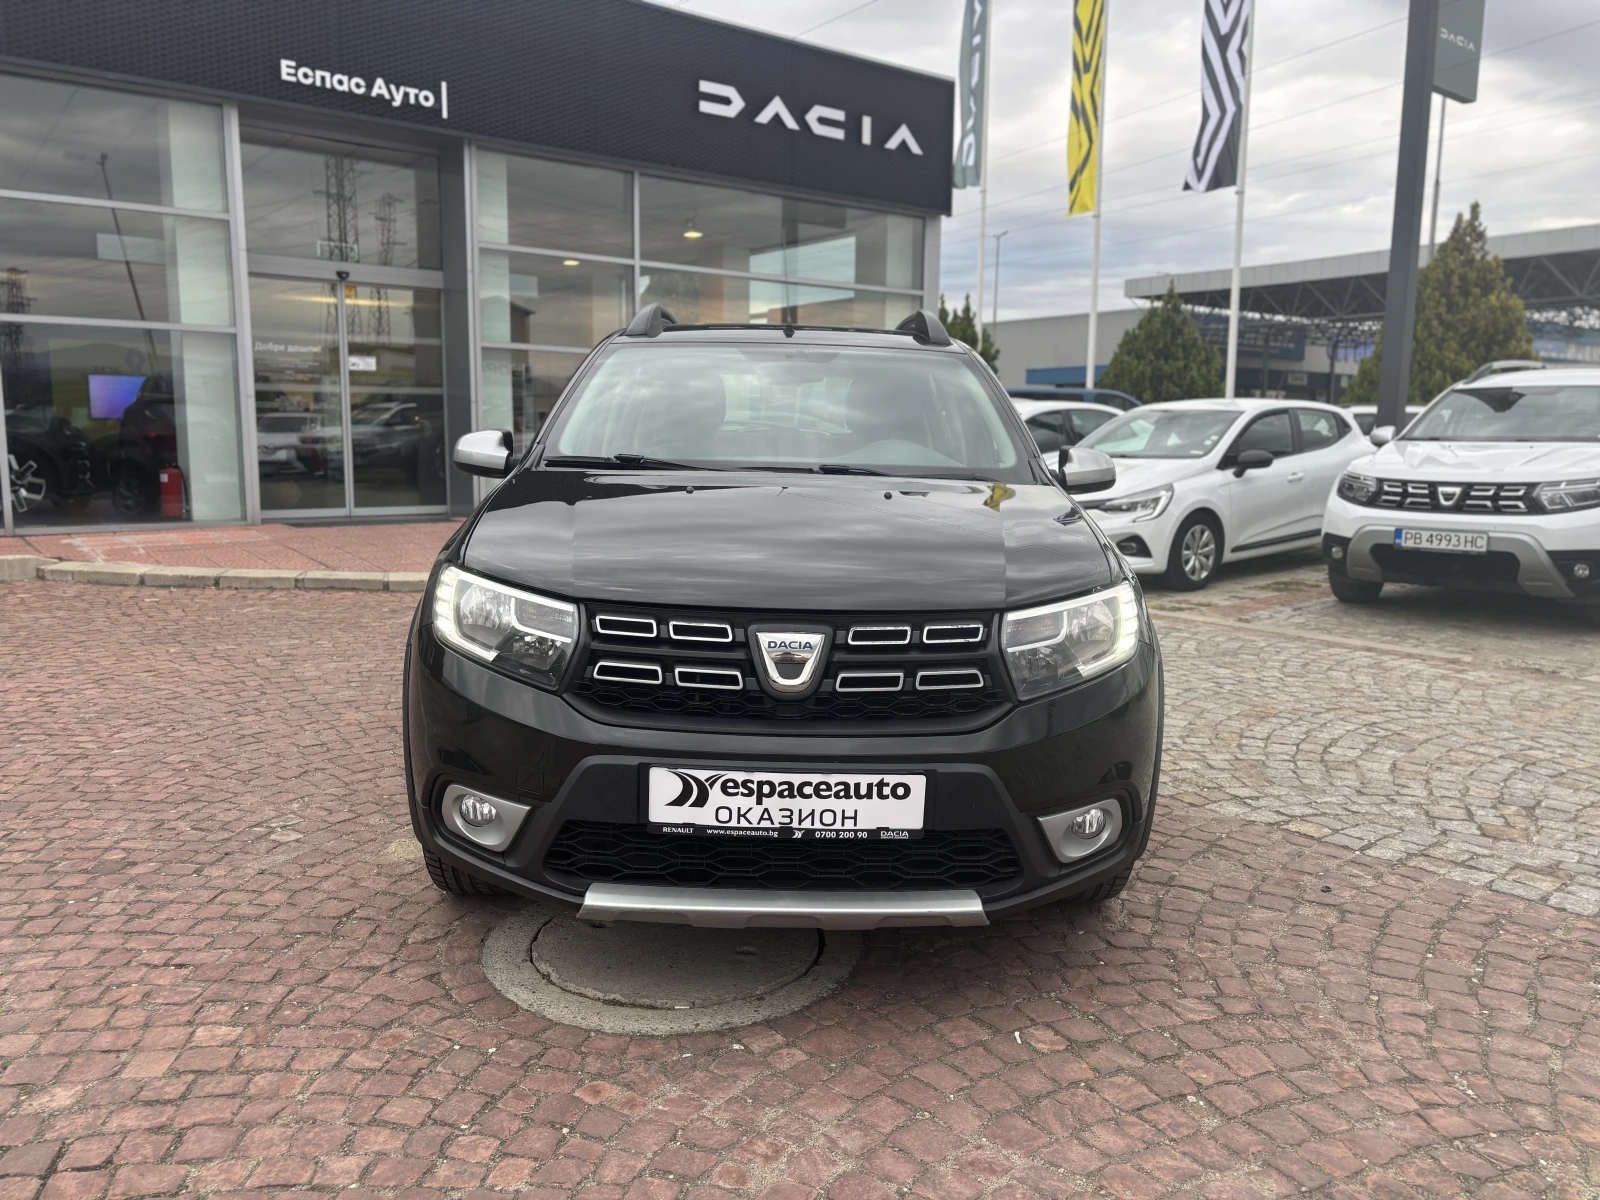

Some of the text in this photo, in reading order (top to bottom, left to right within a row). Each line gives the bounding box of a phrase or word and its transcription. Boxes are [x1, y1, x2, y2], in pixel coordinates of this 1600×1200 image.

[1440, 27, 1475, 52] DACIA
[280, 58, 436, 108] Еспас Ауто
[699, 79, 924, 156] DACIA
[1404, 531, 1485, 549] PB 4993 HC
[768, 641, 814, 650] DACIA
[719, 777, 912, 806] espaceauto
[714, 805, 859, 828] ОКАЗИОН
[662, 826, 694, 834] RENAULT
[706, 828, 779, 838] www.espaceauto.bg
[815, 831, 836, 839] 0700
[839, 831, 855, 839] 200
[857, 831, 868, 839] 90
